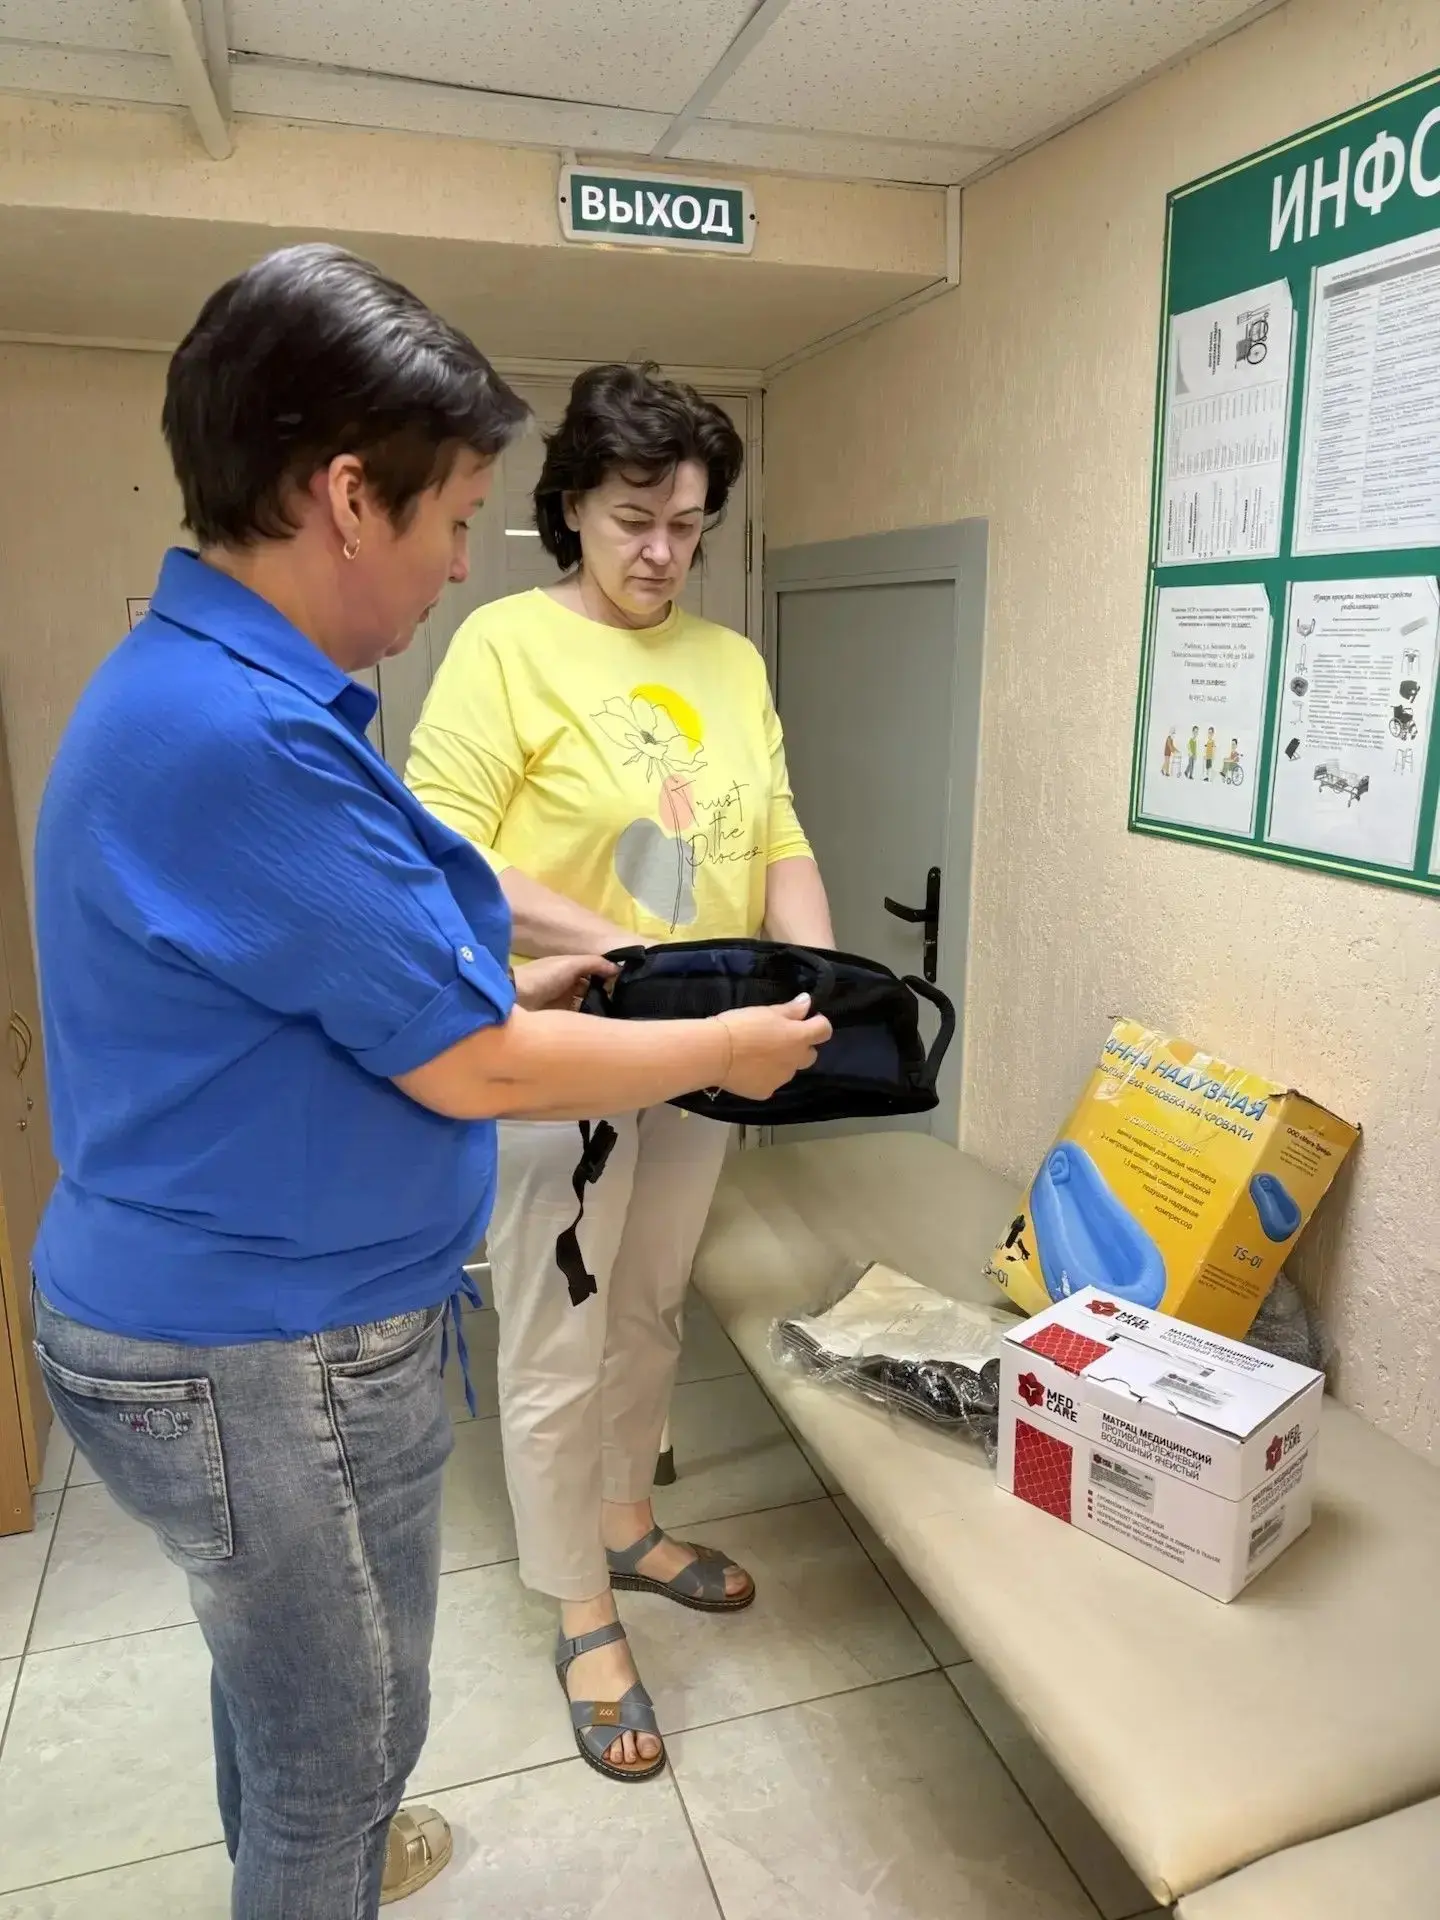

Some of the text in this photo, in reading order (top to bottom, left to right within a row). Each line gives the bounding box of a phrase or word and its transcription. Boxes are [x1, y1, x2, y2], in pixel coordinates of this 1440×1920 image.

[581, 185, 733, 237] ВЫХОД
[671, 779, 749, 827] Trust
[709, 811, 745, 858] the
[1151, 1059, 1268, 1121] НАДУВНАЯ
[1145, 1083, 1186, 1109] ЧЕЛОВЕКА
[1186, 1103, 1202, 1117] НА
[1203, 1110, 1254, 1141] КРОВАТИ
[1154, 1205, 1193, 1230] компрессор
[1233, 1245, 1263, 1268] TS-01
[1115, 1316, 1150, 1331] CARE
[1118, 1311, 1149, 1325] MED
[1169, 1328, 1204, 1344] МАТРАЦ
[1046, 1399, 1078, 1423] CARE
[1047, 1389, 1074, 1409] MED
[1102, 1413, 1212, 1466] МАТРАЦ МЕДИЦИНСКИЙ
[1283, 1431, 1302, 1455] CARE
[1284, 1423, 1300, 1444] MED
[1101, 1422, 1202, 1471] ПРОТИВОПРОЛЕЖНЕВЫЙ
[1101, 1431, 1152, 1461] ВОЗДУШНЫЙ
[1154, 1454, 1200, 1481] ЯЧЕИСТЫЙ
